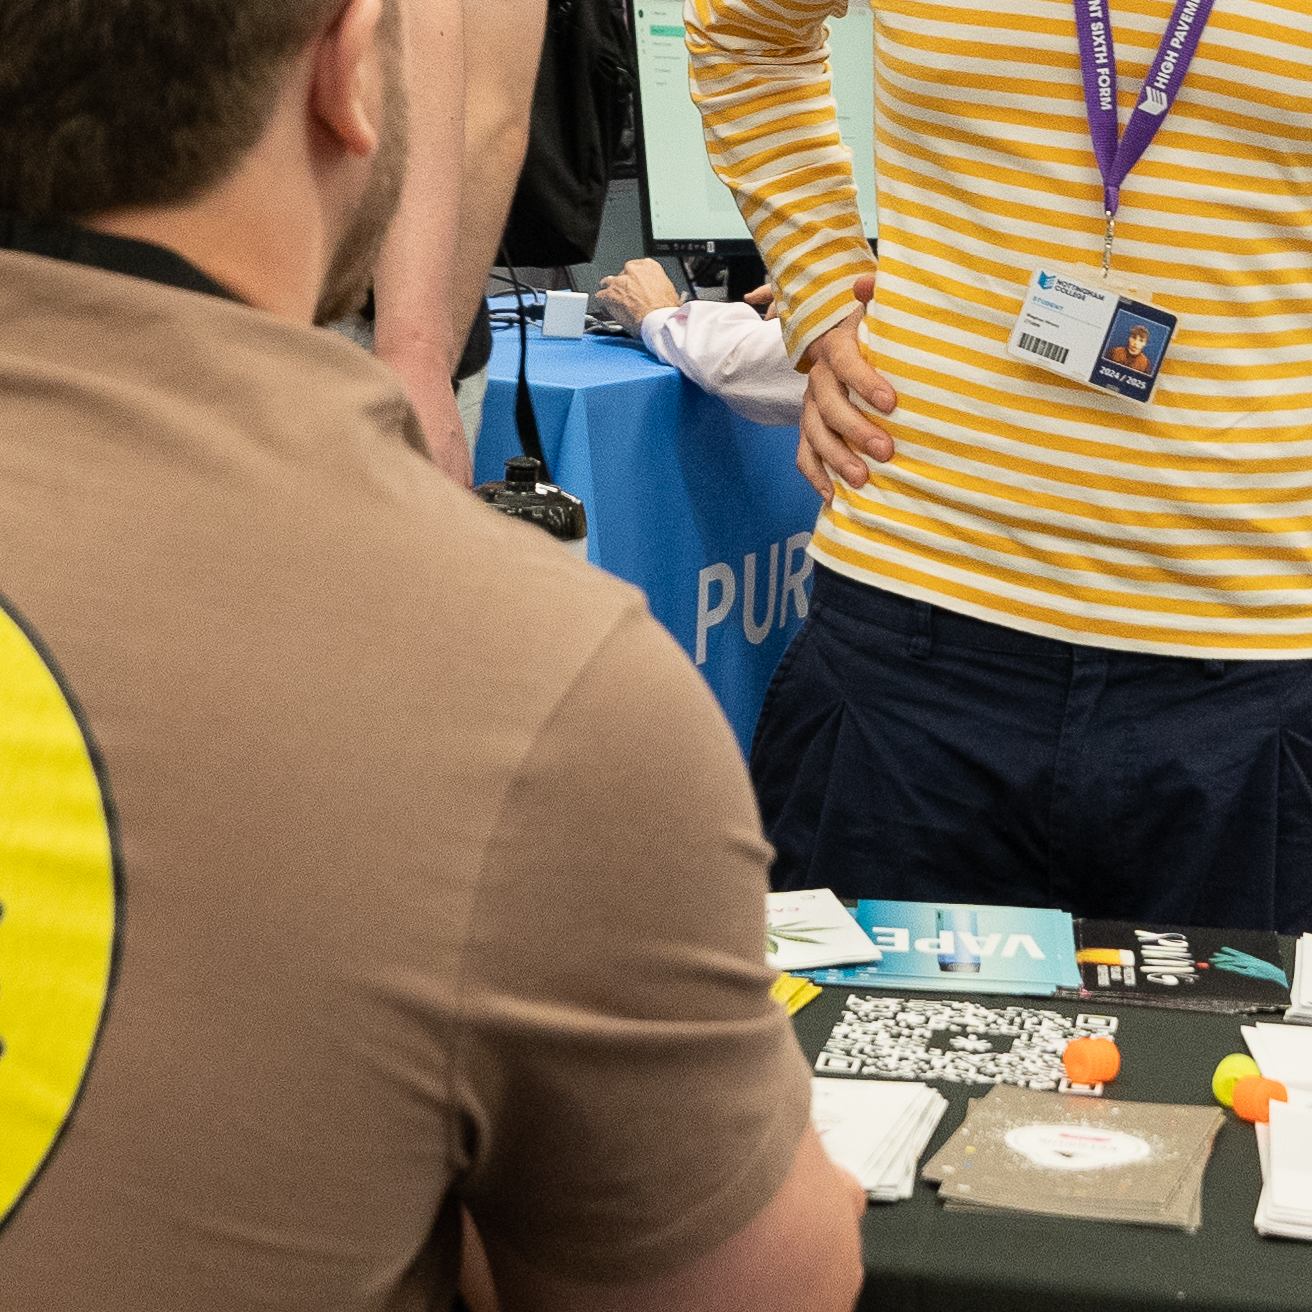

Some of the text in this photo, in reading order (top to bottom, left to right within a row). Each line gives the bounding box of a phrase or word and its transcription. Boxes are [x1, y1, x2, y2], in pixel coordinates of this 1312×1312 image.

[1090, 22, 1109, 65] SIXTH
[1096, 67, 1113, 111] FORM
[1153, 50, 1180, 90] HIGH
[1054, 285, 1086, 301] COLLEGE
[1056, 278, 1105, 302] NOTTINGHAM
[695, 531, 815, 666] PUR
[870, 925, 1046, 960] VAPE
